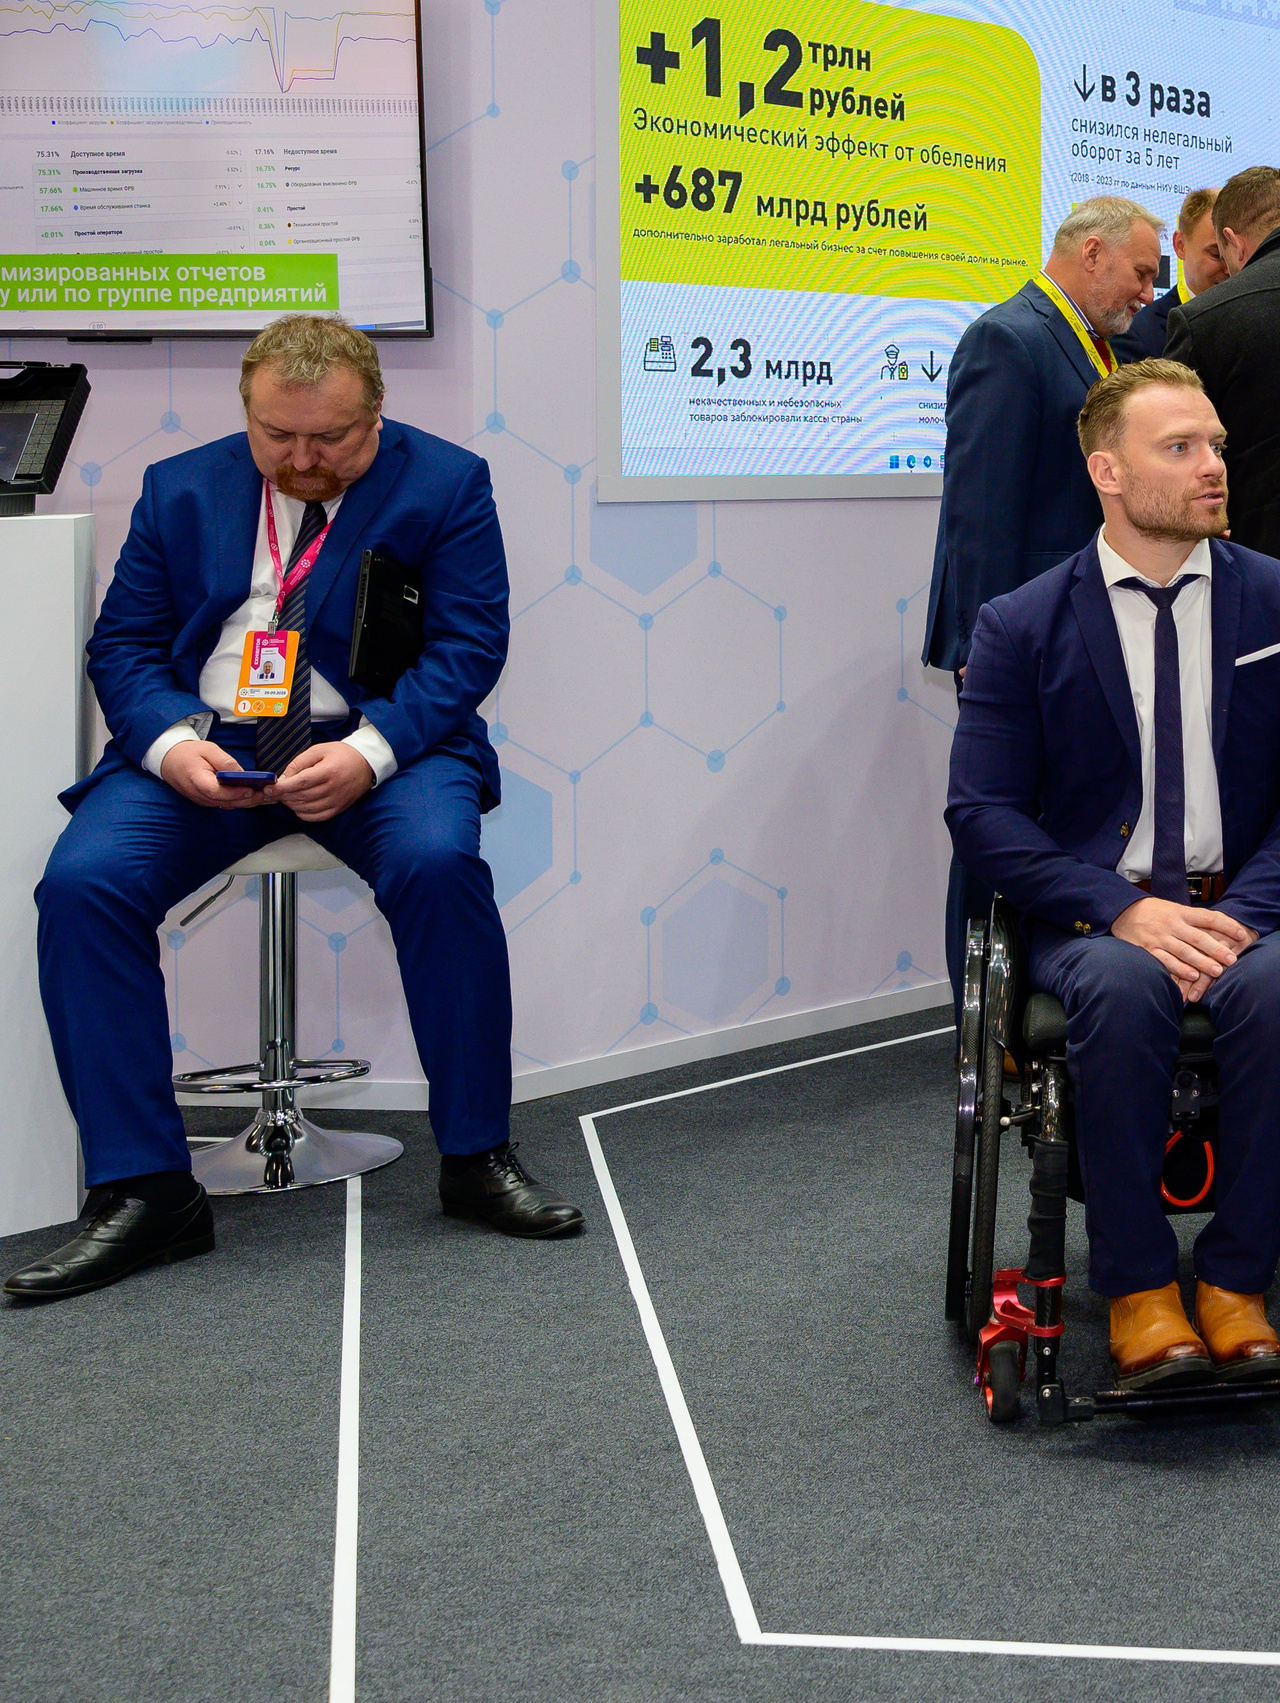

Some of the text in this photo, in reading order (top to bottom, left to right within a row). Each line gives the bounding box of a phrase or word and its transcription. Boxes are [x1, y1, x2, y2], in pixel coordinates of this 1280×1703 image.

[636, 16, 803, 119] +1,2
[808, 40, 871, 72] трлн
[810, 87, 906, 121] рублей
[1101, 71, 1211, 118] в 3 раза
[633, 107, 1008, 173] Экономический эффект от обеления
[1071, 117, 1233, 154] снизился нелегальный
[36, 150, 60, 158] 75.31%
[70, 150, 104, 158] Доступное
[283, 148, 320, 156] Недоступное
[1071, 139, 1180, 170] оборот за 5 лет
[635, 165, 928, 231] +687 млрд рублей
[1070, 172, 1090, 184] (2018
[1096, 175, 1113, 186] 2023
[1120, 180, 1130, 188] по
[1130, 181, 1156, 191] данным
[1156, 182, 1173, 193] НИУ
[97, 203, 133, 211] обслуживания
[74, 229, 96, 237] Простой
[632, 228, 1029, 267] дополнительно заработал легальный бизнес за счет повышения своей доли на рынке.
[1, 266, 266, 287] мизированных отчетов
[17, 287, 57, 303] или
[64, 287, 91, 303] по
[98, 287, 172, 308] группе
[179, 282, 328, 308] предприятий
[690, 336, 833, 388] 2,3 млрд
[688, 397, 842, 408] некачественных и небезопасных
[689, 412, 863, 425] товаров заблокировали кассы страны
